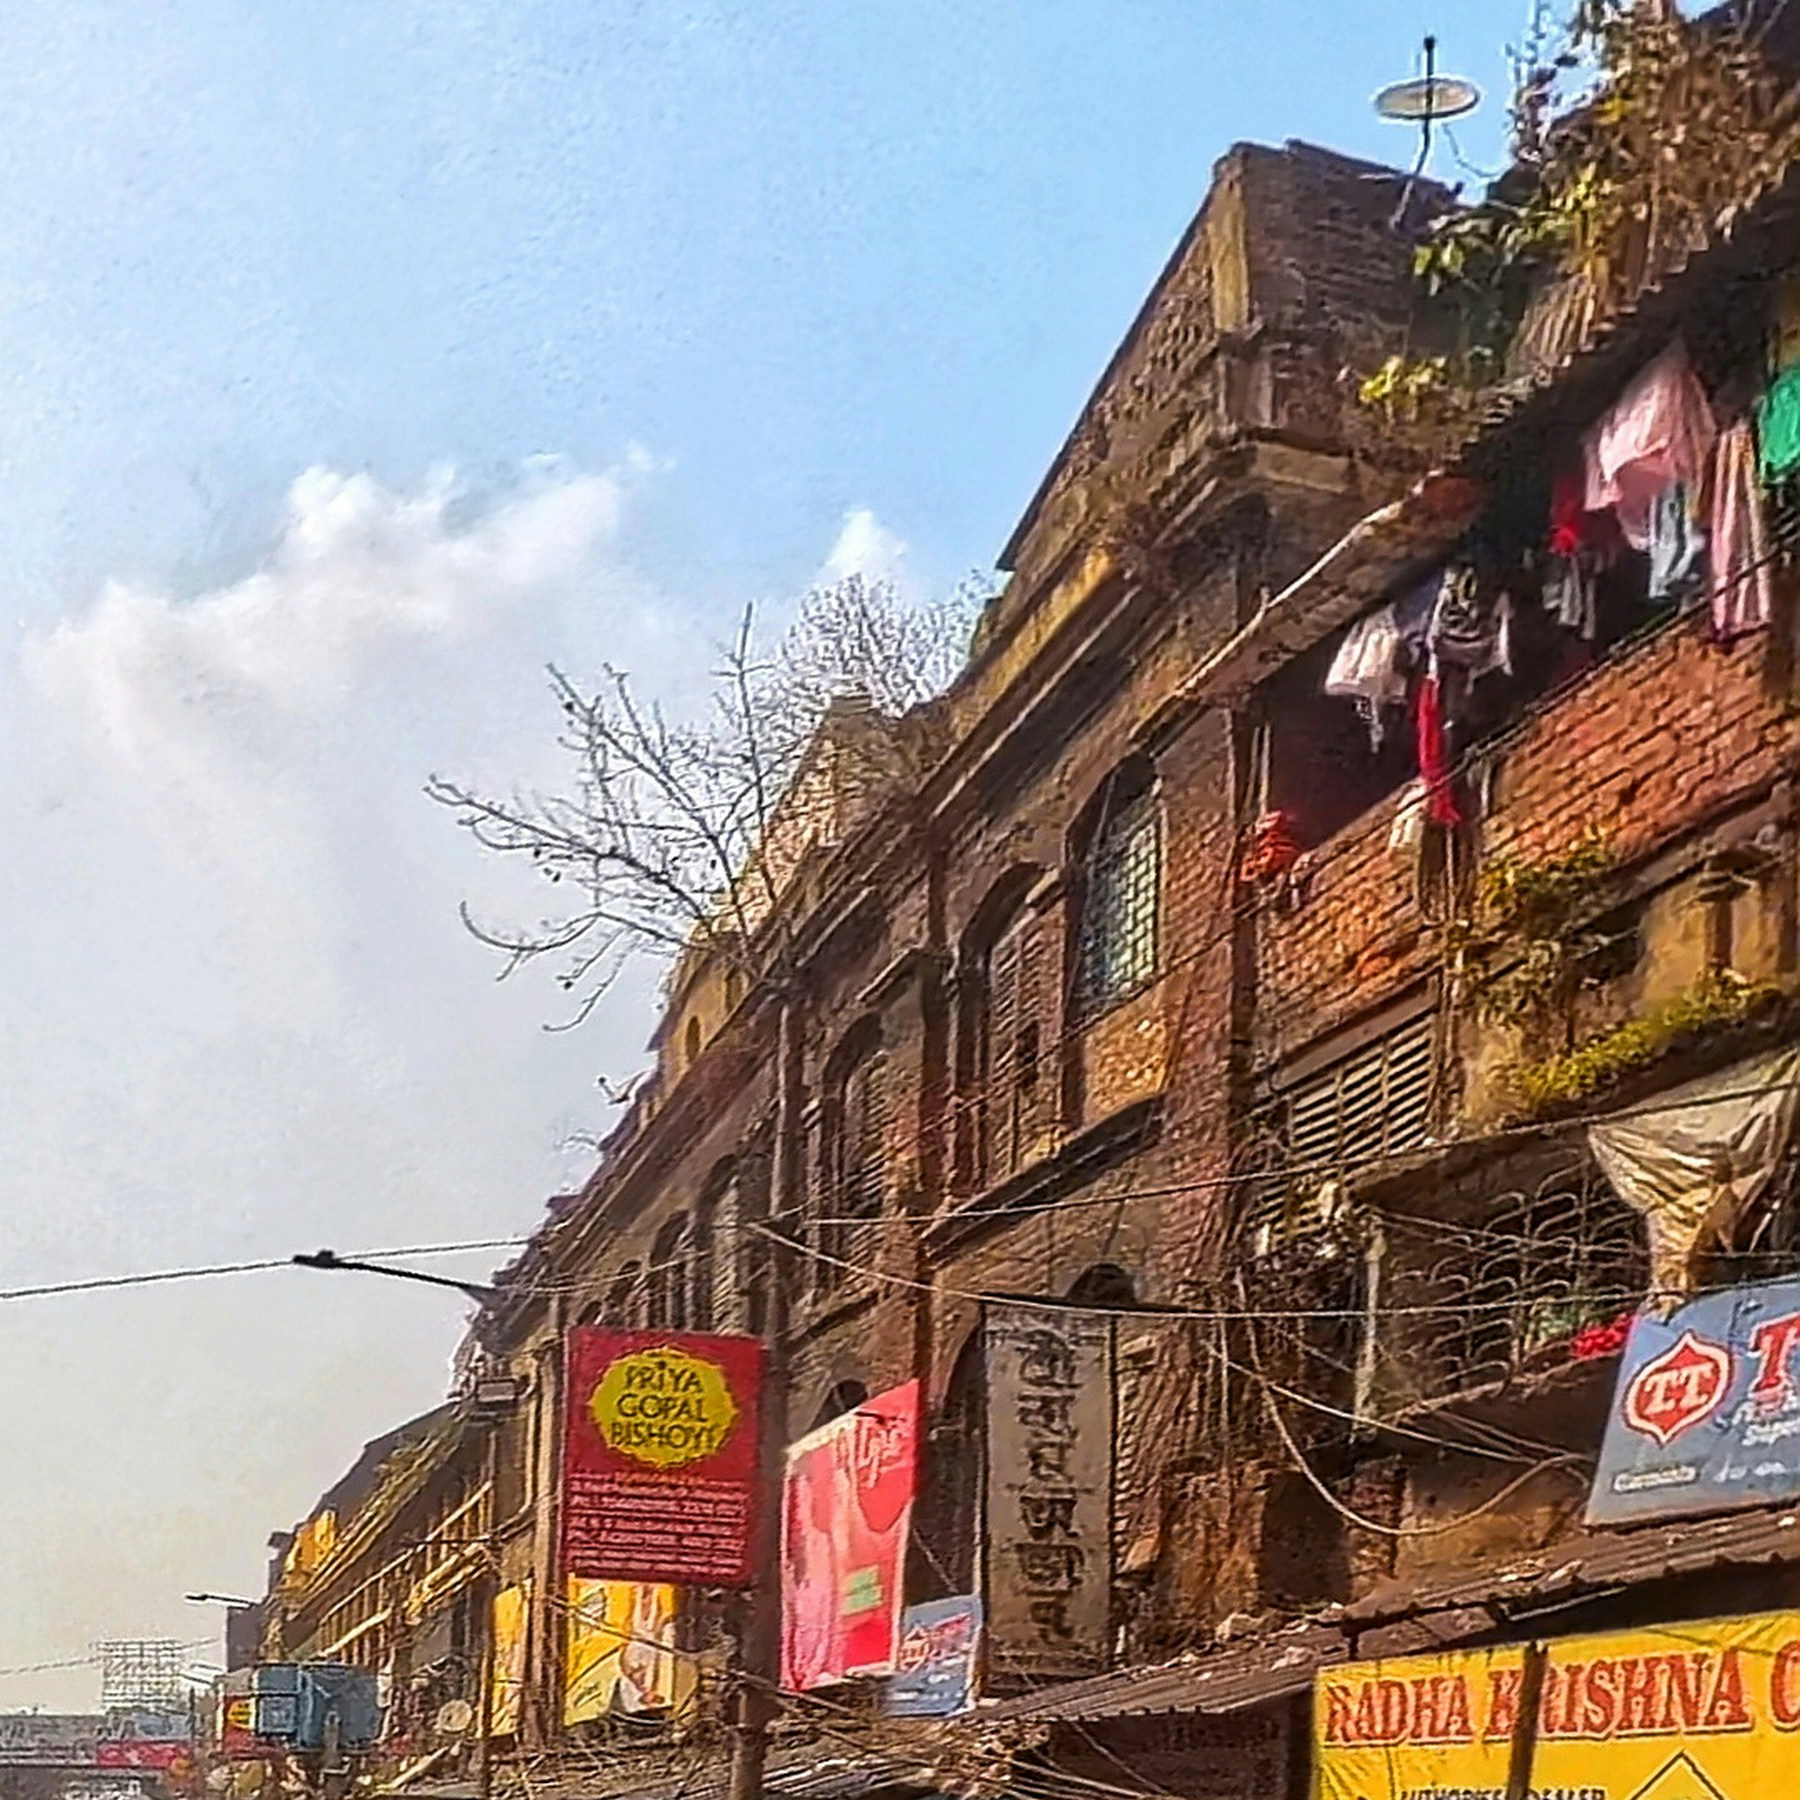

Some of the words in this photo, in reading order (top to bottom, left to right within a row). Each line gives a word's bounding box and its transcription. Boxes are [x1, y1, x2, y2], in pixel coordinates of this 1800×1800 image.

[624, 1360, 704, 1393] PRIYA
[1643, 1362, 1714, 1416] TT
[616, 1392, 709, 1423] GOPAL
[1324, 1675, 1475, 1743] RADHA
